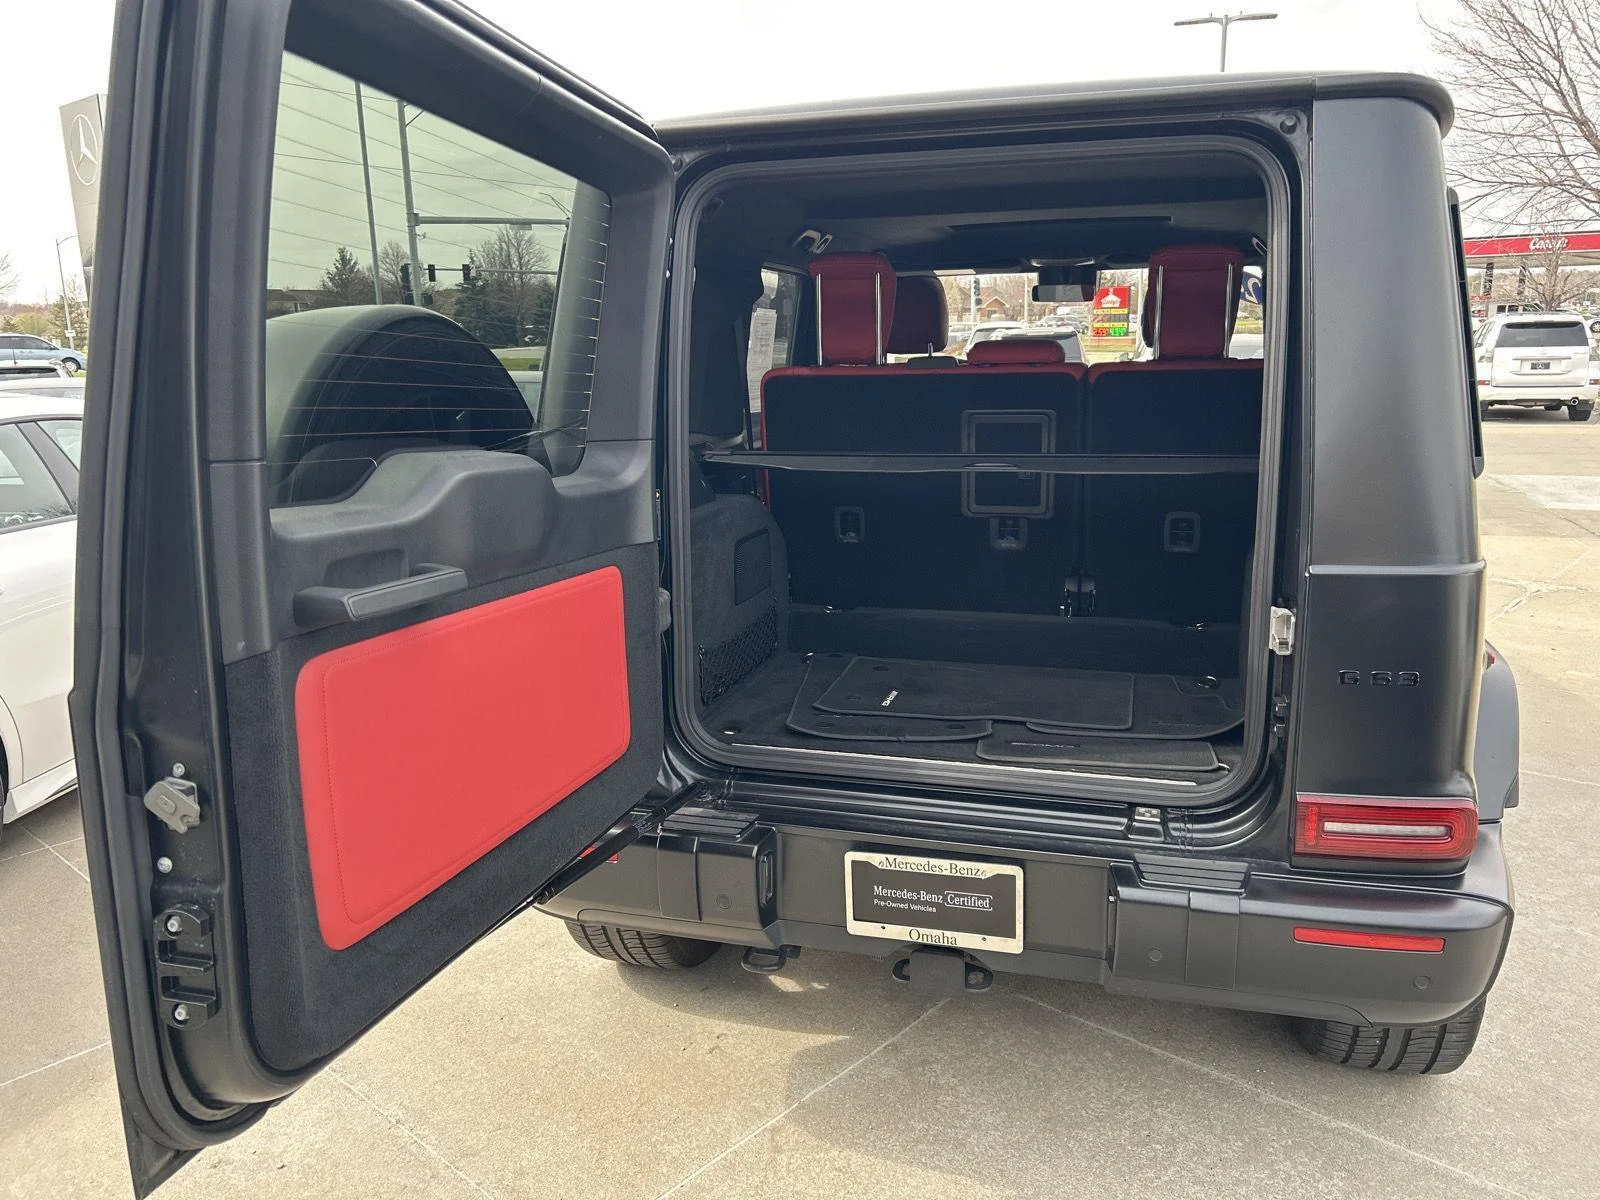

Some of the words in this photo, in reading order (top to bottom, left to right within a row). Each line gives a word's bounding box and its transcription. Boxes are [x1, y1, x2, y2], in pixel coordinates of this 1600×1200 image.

[884, 856, 981, 877] Mercedes-Benz
[873, 885, 943, 904] Mercedes-Benz
[947, 893, 990, 908] Certified
[873, 899, 909, 910] Pre-Owned
[909, 903, 937, 913] Vehicles
[908, 928, 958, 946] Omaha
